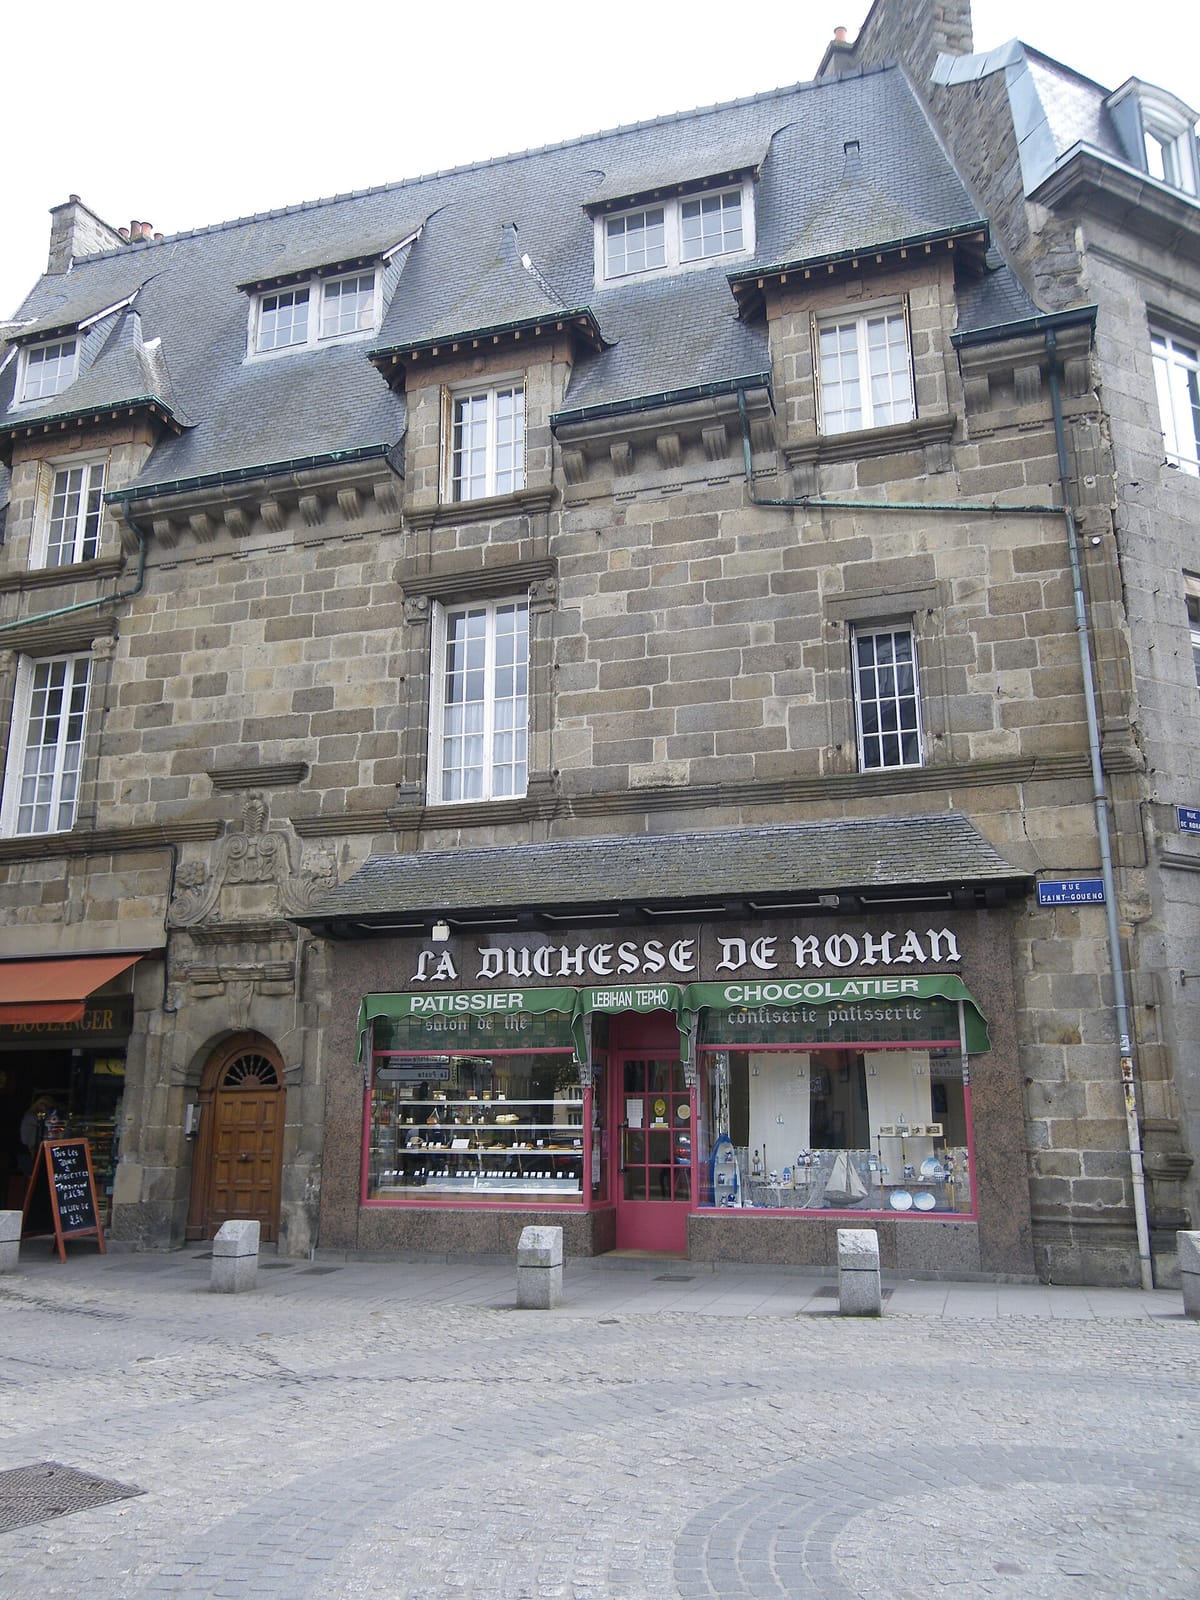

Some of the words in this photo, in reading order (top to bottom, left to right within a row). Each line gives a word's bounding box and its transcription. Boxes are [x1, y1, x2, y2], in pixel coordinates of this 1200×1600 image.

[1061, 883, 1080, 891] RUE
[1041, 892, 1103, 902] SAINT-GOUENO
[409, 949, 459, 982] LA
[475, 938, 697, 981] DUCHESSE
[715, 935, 779, 972] DE
[791, 927, 962, 970] ROHAN
[591, 991, 633, 1008] LEBIHAN
[635, 988, 669, 1006] TEPHO
[723, 979, 919, 1003] CHOCOLATIER
[409, 993, 524, 1012] PATISSIER
[425, 1015, 468, 1031] salon
[728, 1006, 817, 1025] confiserie
[827, 1004, 922, 1027] patisserie
